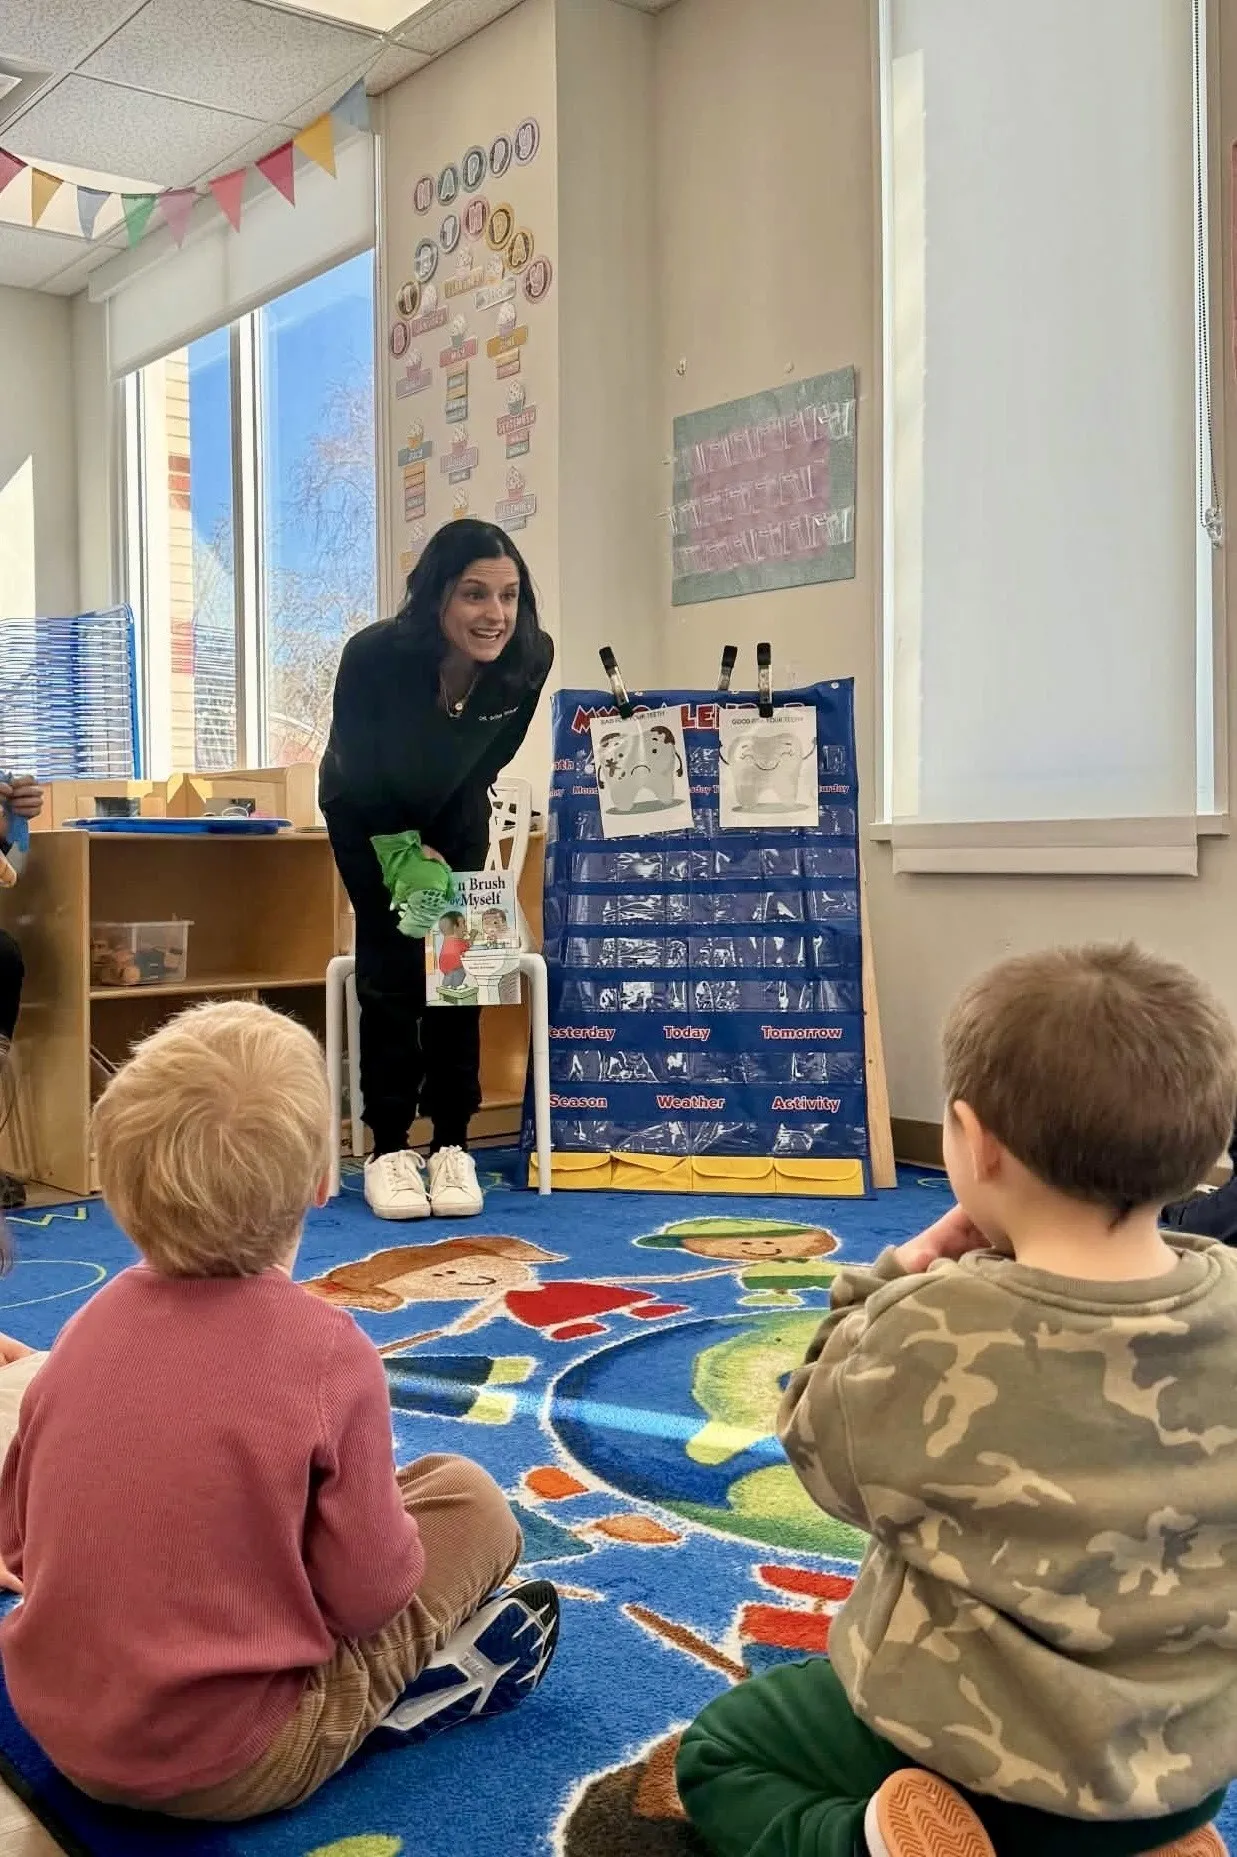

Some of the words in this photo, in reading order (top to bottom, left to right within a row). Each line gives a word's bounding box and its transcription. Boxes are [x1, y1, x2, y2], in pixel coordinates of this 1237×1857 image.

[820, 784, 850, 795] urday
[469, 875, 506, 891] Brush
[460, 891, 501, 910] Myself
[549, 1025, 616, 1041] esterday
[663, 1025, 711, 1042] Today
[761, 1025, 843, 1040] Tomorrow
[548, 1093, 608, 1109] Season
[656, 1095, 726, 1110] Weather
[771, 1095, 841, 1114] Activity
